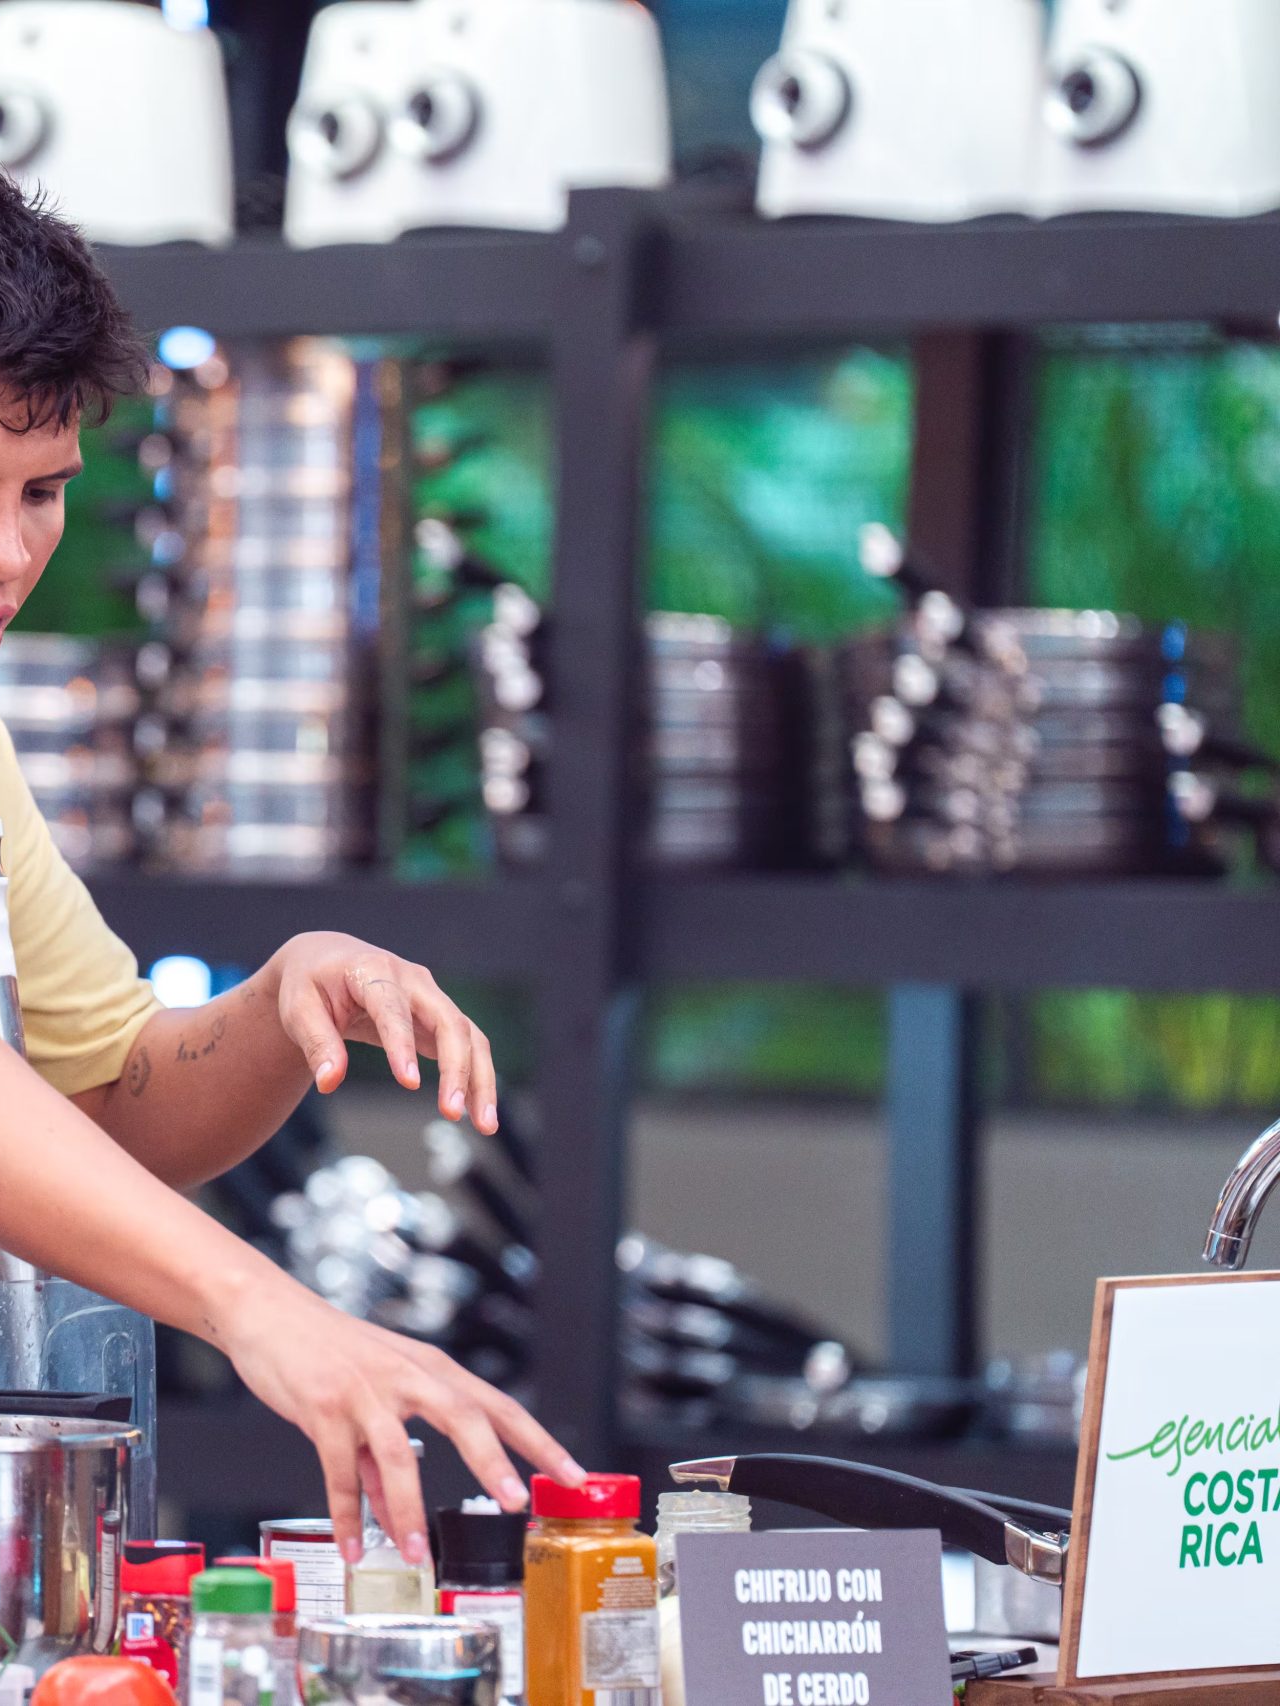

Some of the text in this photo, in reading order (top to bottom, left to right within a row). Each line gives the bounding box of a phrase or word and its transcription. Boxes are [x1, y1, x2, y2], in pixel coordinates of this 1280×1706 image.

[1106, 1402, 1280, 1477] esencia
[1179, 1521, 1263, 1568] RICA
[734, 1568, 883, 1603] CHIFRIJO CON
[742, 1610, 883, 1655] CHICHARRÓN
[762, 1671, 870, 1706] DE CERDO
